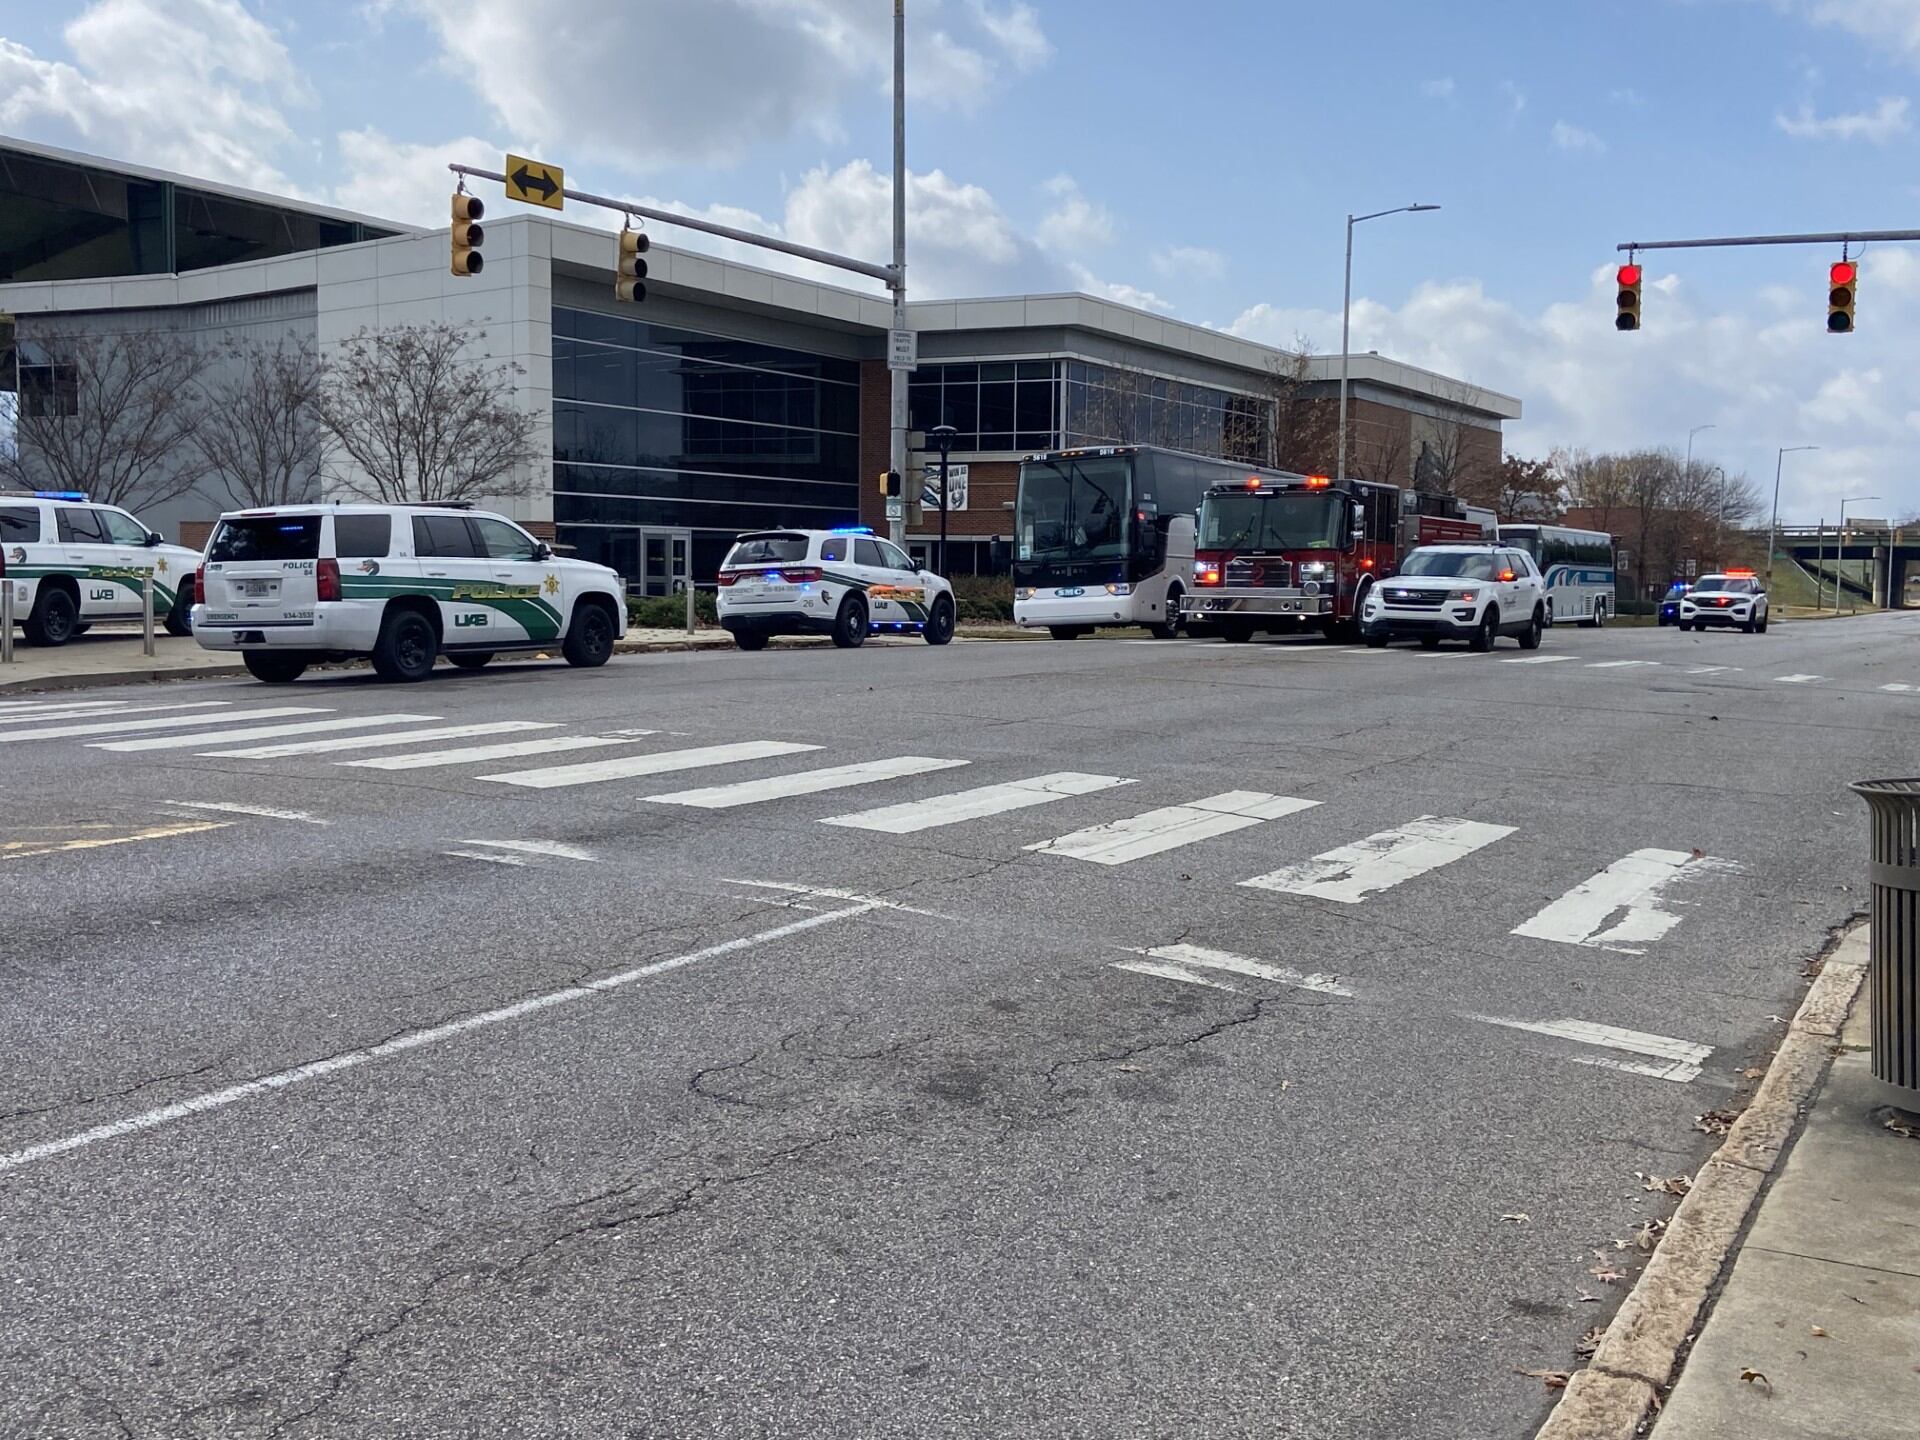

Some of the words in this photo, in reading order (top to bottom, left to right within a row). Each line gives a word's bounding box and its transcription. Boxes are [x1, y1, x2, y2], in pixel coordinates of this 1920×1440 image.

[948, 477, 967, 492] ONE
[282, 561, 314, 569] POLICE
[87, 566, 155, 578] POLICE
[1251, 565, 1265, 585] 2
[90, 589, 114, 600] UAB
[452, 584, 541, 599] POLICE
[1057, 588, 1083, 597] SMC
[802, 600, 814, 608] 26
[874, 601, 888, 609] UAB
[454, 613, 489, 627] UAB
